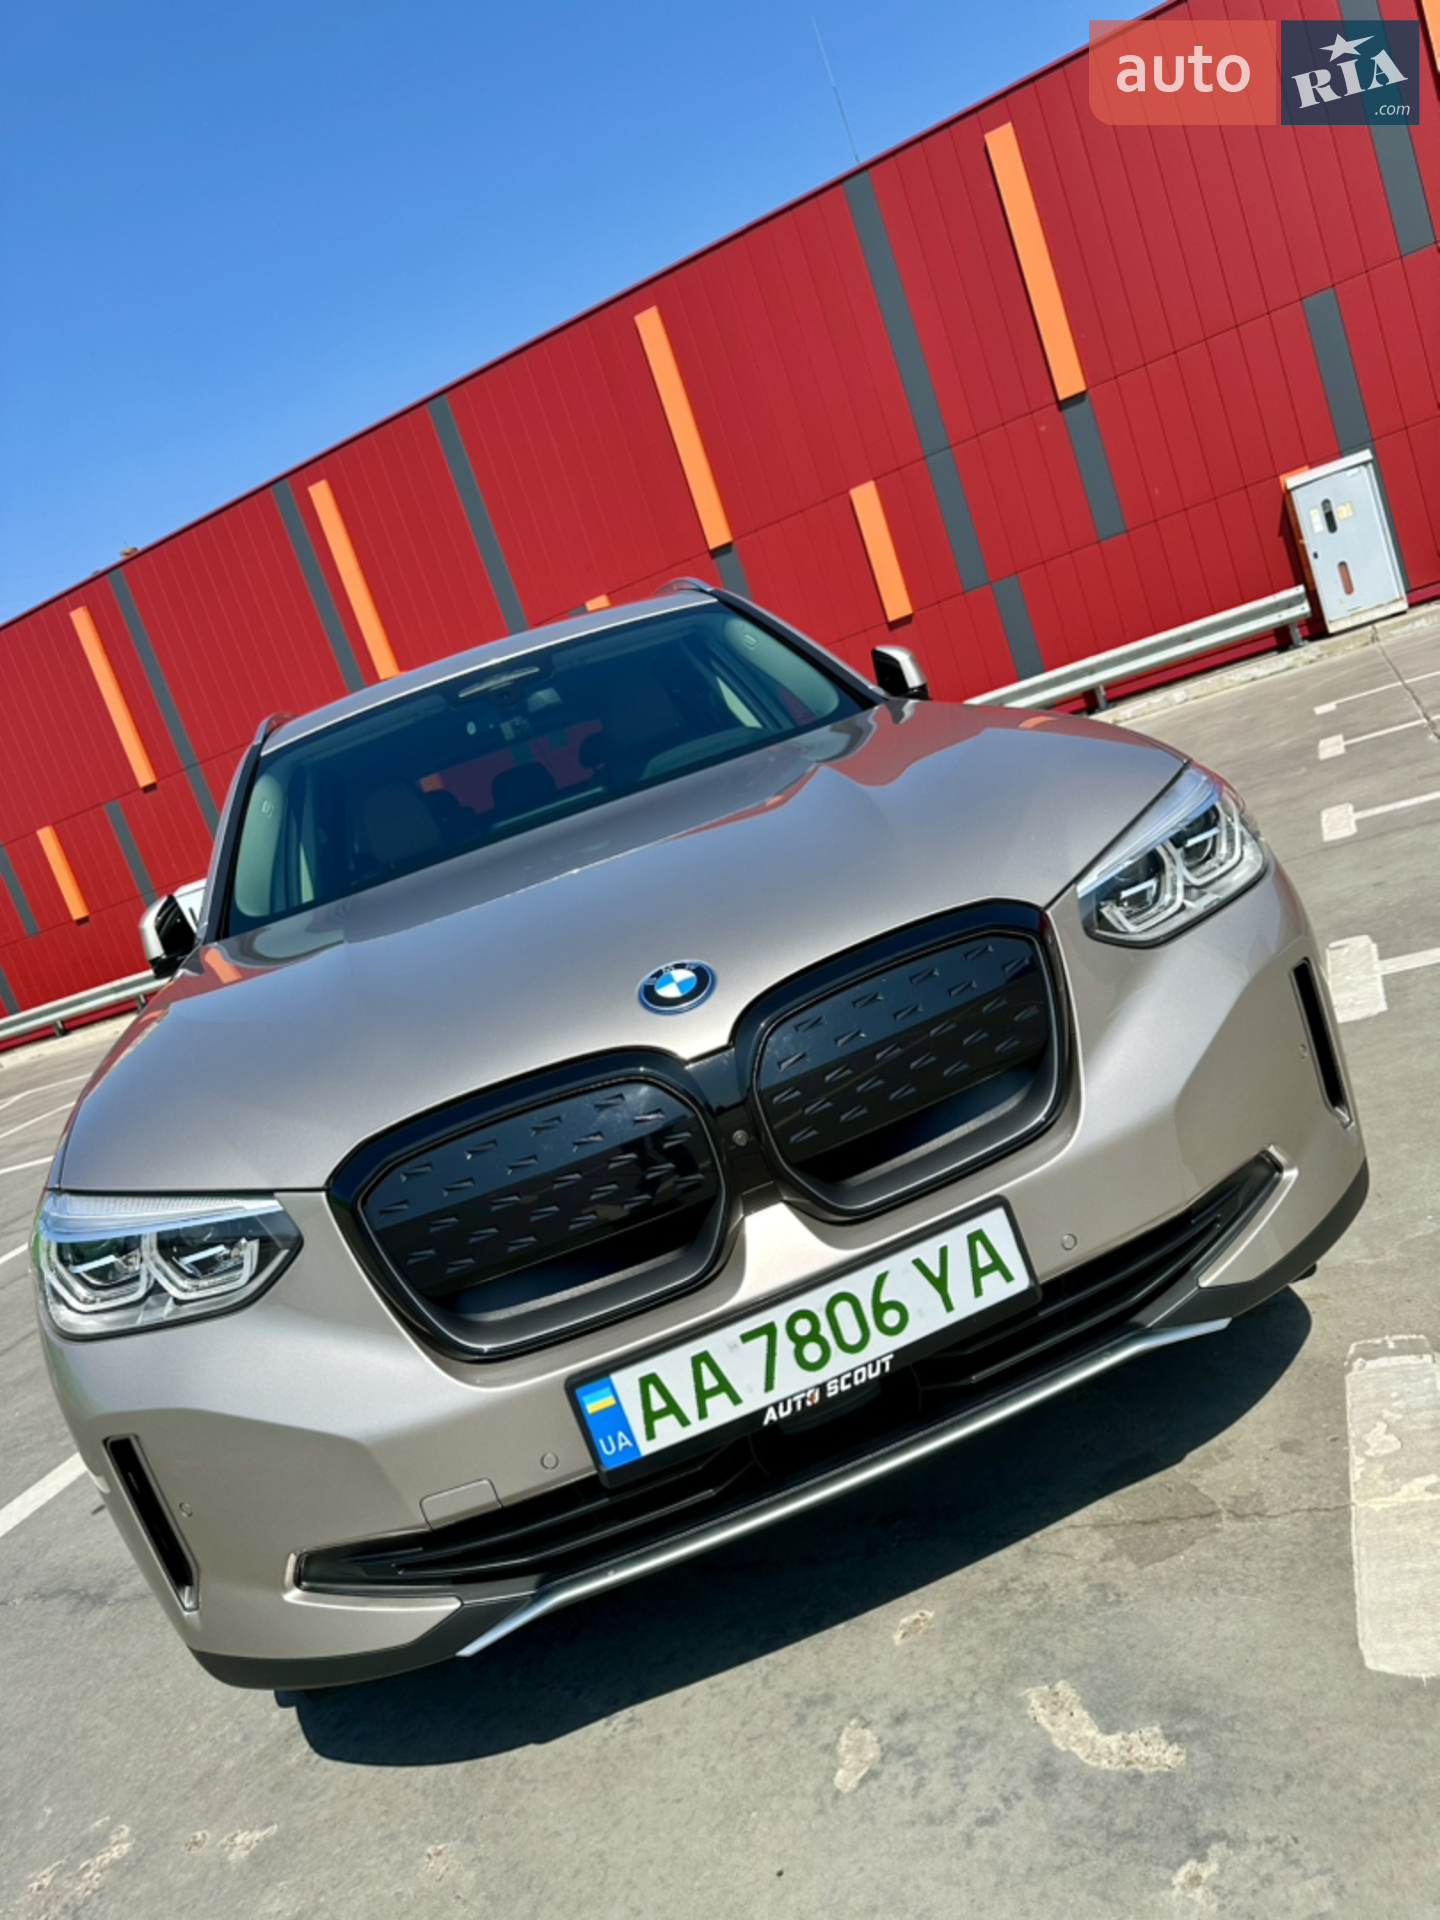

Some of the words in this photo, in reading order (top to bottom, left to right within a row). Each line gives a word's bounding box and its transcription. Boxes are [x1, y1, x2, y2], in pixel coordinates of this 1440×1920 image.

[762, 1387, 821, 1427] AUTO
[826, 1353, 895, 1398] SCOUT
[598, 1430, 634, 1456] UA
